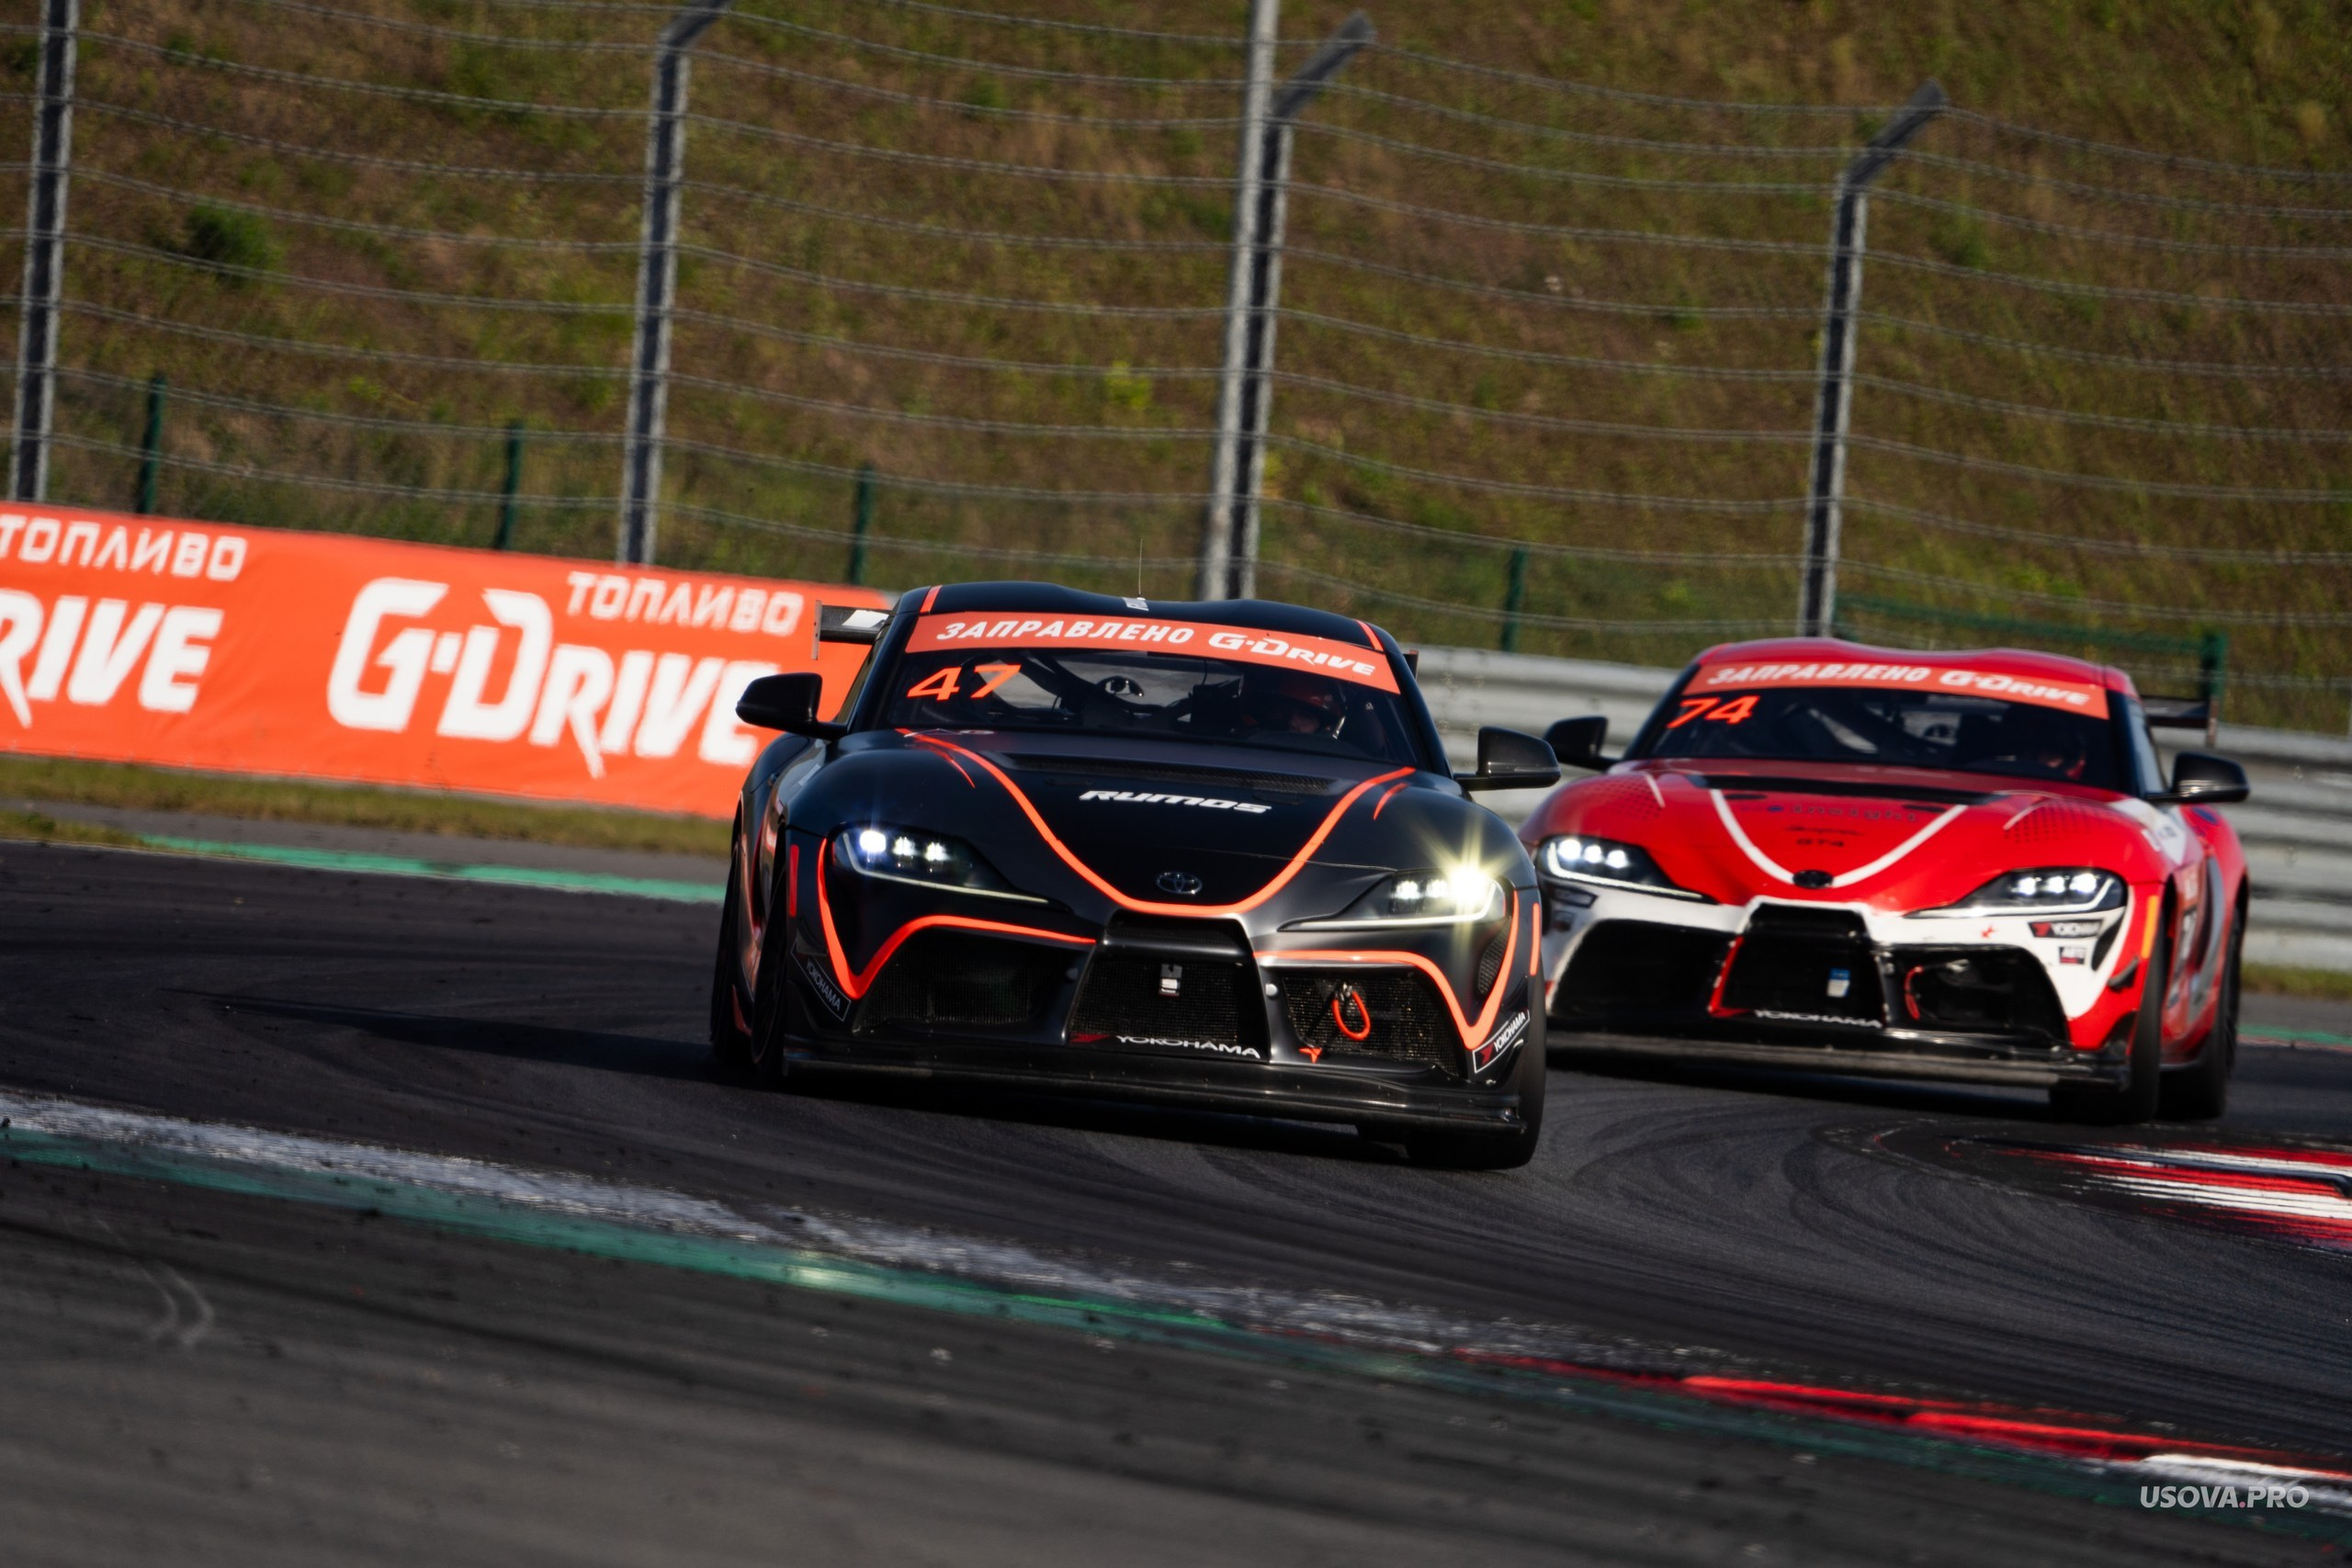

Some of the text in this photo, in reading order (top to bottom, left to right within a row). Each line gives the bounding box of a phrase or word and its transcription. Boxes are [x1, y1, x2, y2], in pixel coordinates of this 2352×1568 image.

[0, 513, 247, 582] ТОПЛИВО
[567, 570, 804, 637] ТОПЛИВО
[936, 620, 1194, 643] ЗАПРАВЛЕНО
[906, 664, 1022, 702] 47
[1707, 663, 1931, 684] ЗАПРАВЛЕНО
[1666, 694, 1761, 729] 74
[806, 957, 842, 1011] YOKOHAMA
[1493, 1011, 1526, 1053] YOKOHAMA
[1755, 1010, 1883, 1029] YOKOHAMA
[1116, 1035, 1261, 1059] YOKOHAMA
